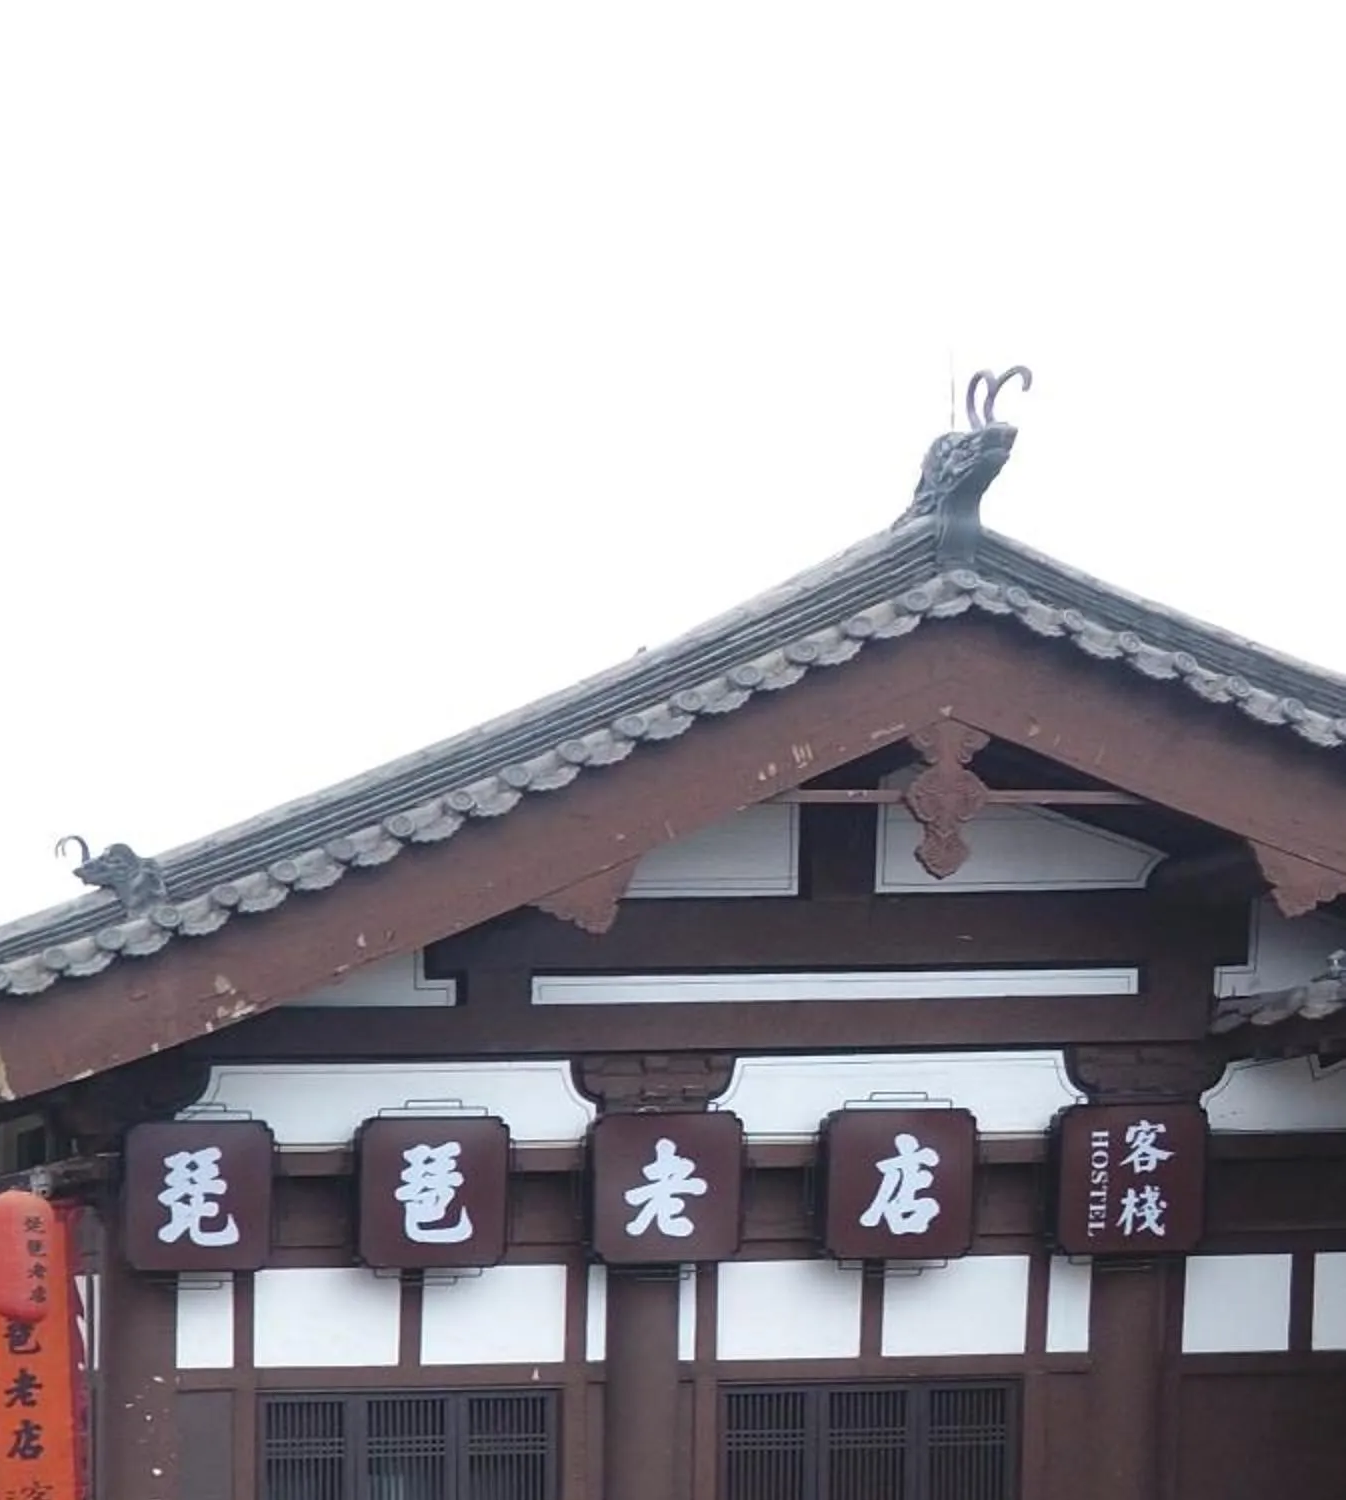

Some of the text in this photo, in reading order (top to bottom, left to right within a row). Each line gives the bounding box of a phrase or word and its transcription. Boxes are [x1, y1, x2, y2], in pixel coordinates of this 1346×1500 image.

[156, 1133, 943, 1246] 琵琶老店
[1087, 1130, 1110, 1238] HOSTEL
